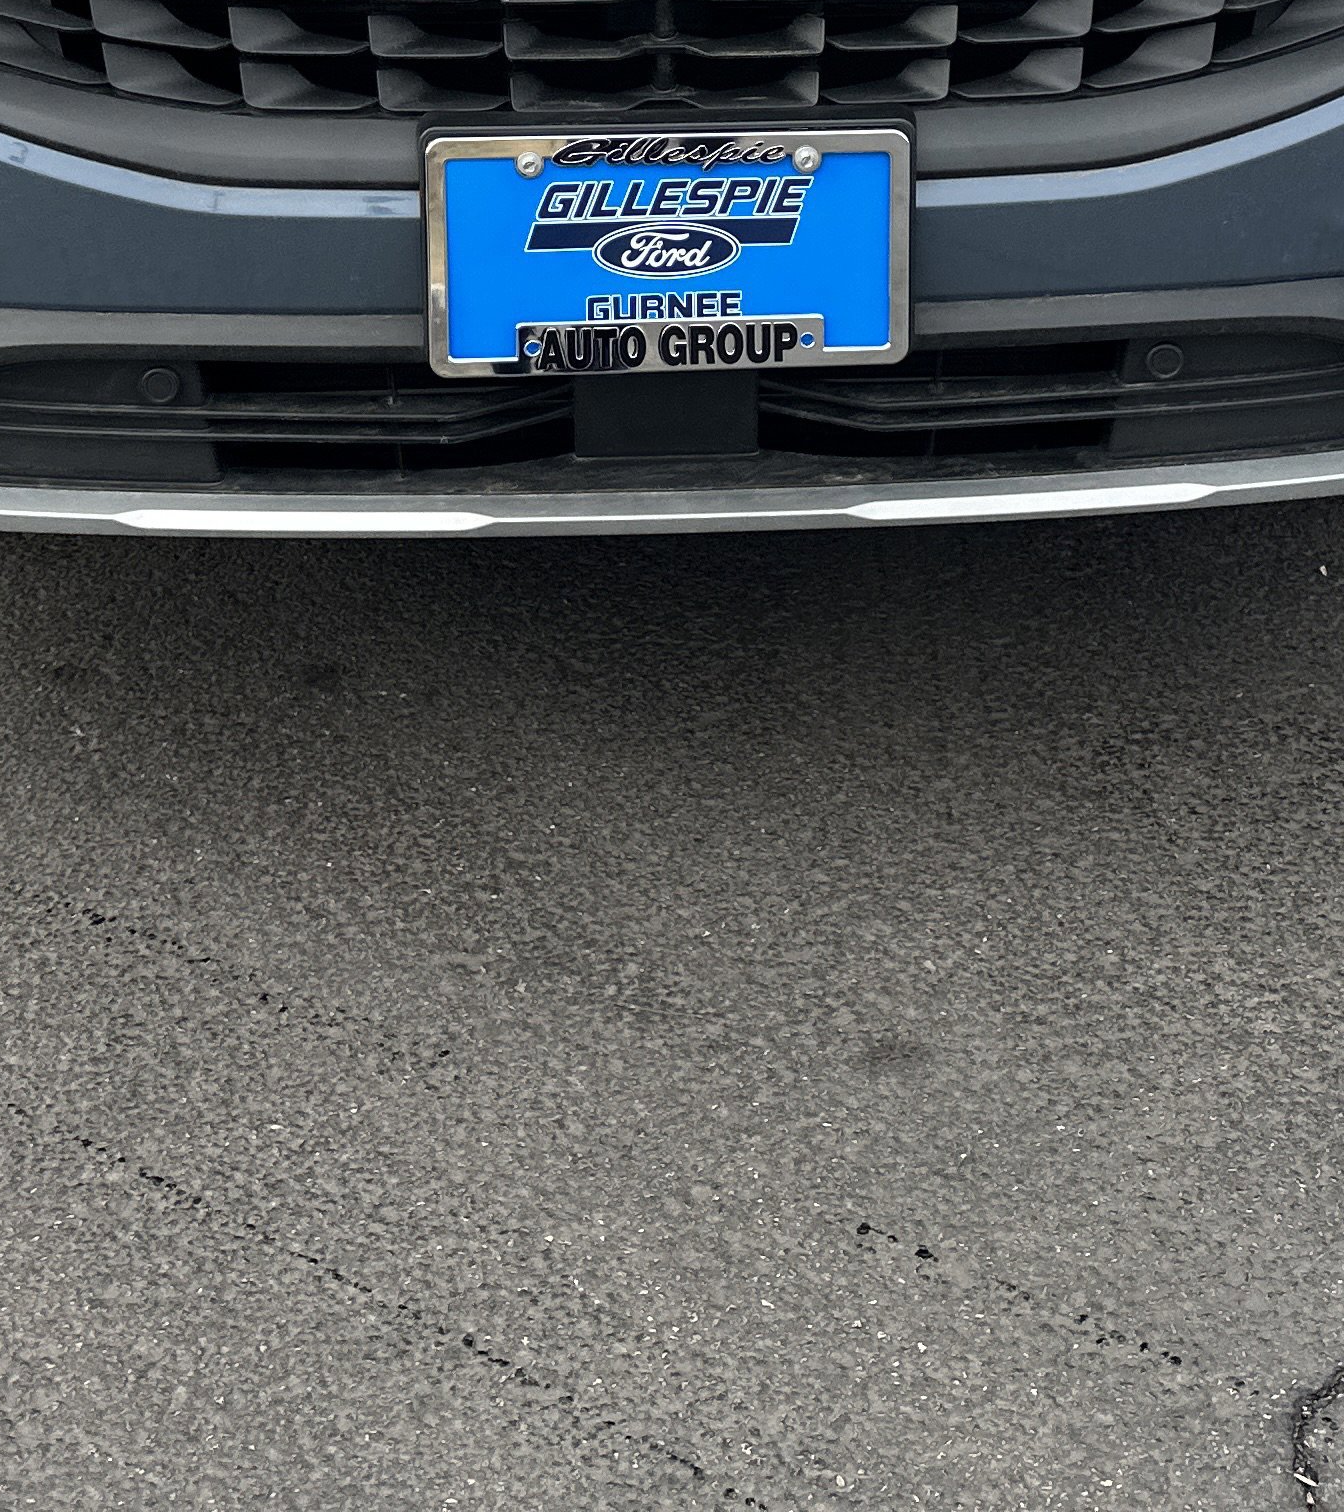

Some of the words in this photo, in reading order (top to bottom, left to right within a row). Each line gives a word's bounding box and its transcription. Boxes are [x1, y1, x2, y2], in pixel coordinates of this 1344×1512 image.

[552, 136, 786, 169] Gillespie
[536, 176, 814, 220] GILLESPIE
[620, 232, 712, 268] Ford
[586, 291, 743, 320] GURNEE
[537, 326, 647, 371] AUTO
[658, 322, 798, 366] GROUP
